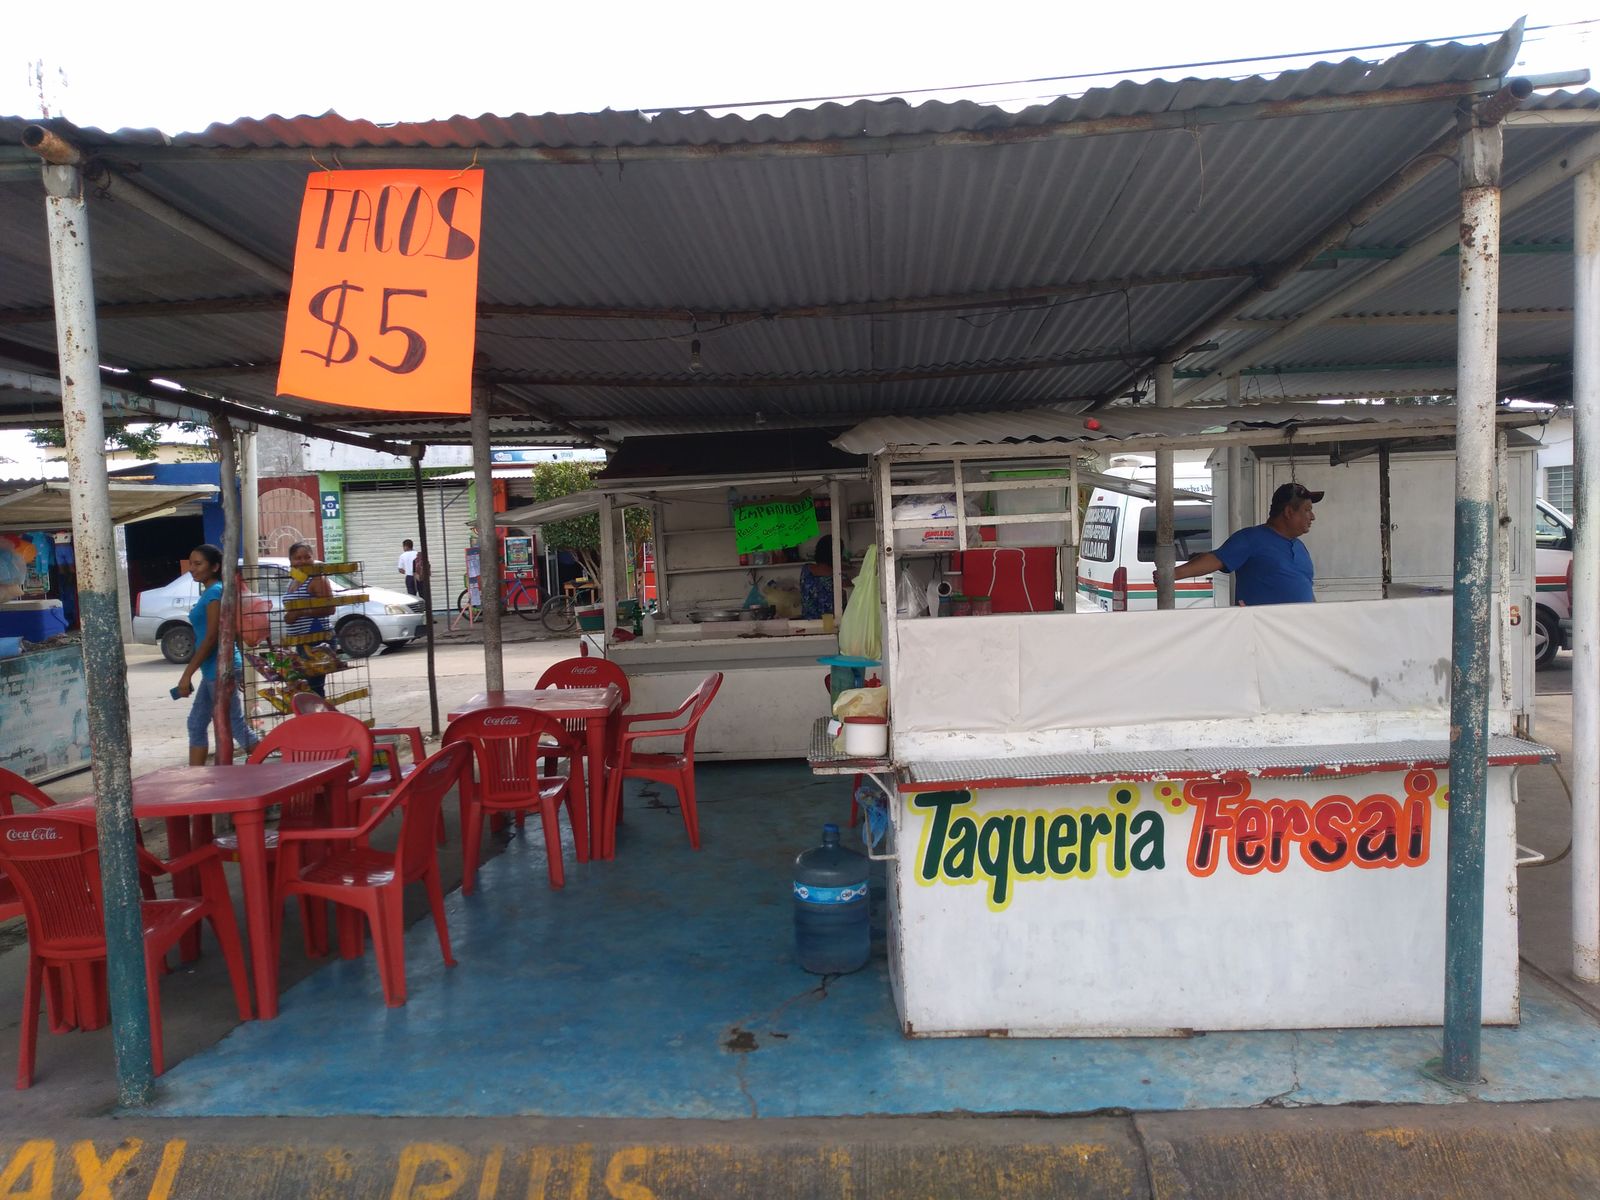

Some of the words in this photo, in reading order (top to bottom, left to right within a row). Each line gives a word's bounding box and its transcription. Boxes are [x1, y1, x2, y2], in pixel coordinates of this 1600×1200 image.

[308, 184, 477, 261] TACOS
[300, 279, 428, 375] $5
[483, 716, 520, 727] Coca-Cola
[6, 827, 58, 841] Coca-Cola
[913, 787, 1166, 906] Taqueria
[1187, 770, 1437, 877] Fersai
